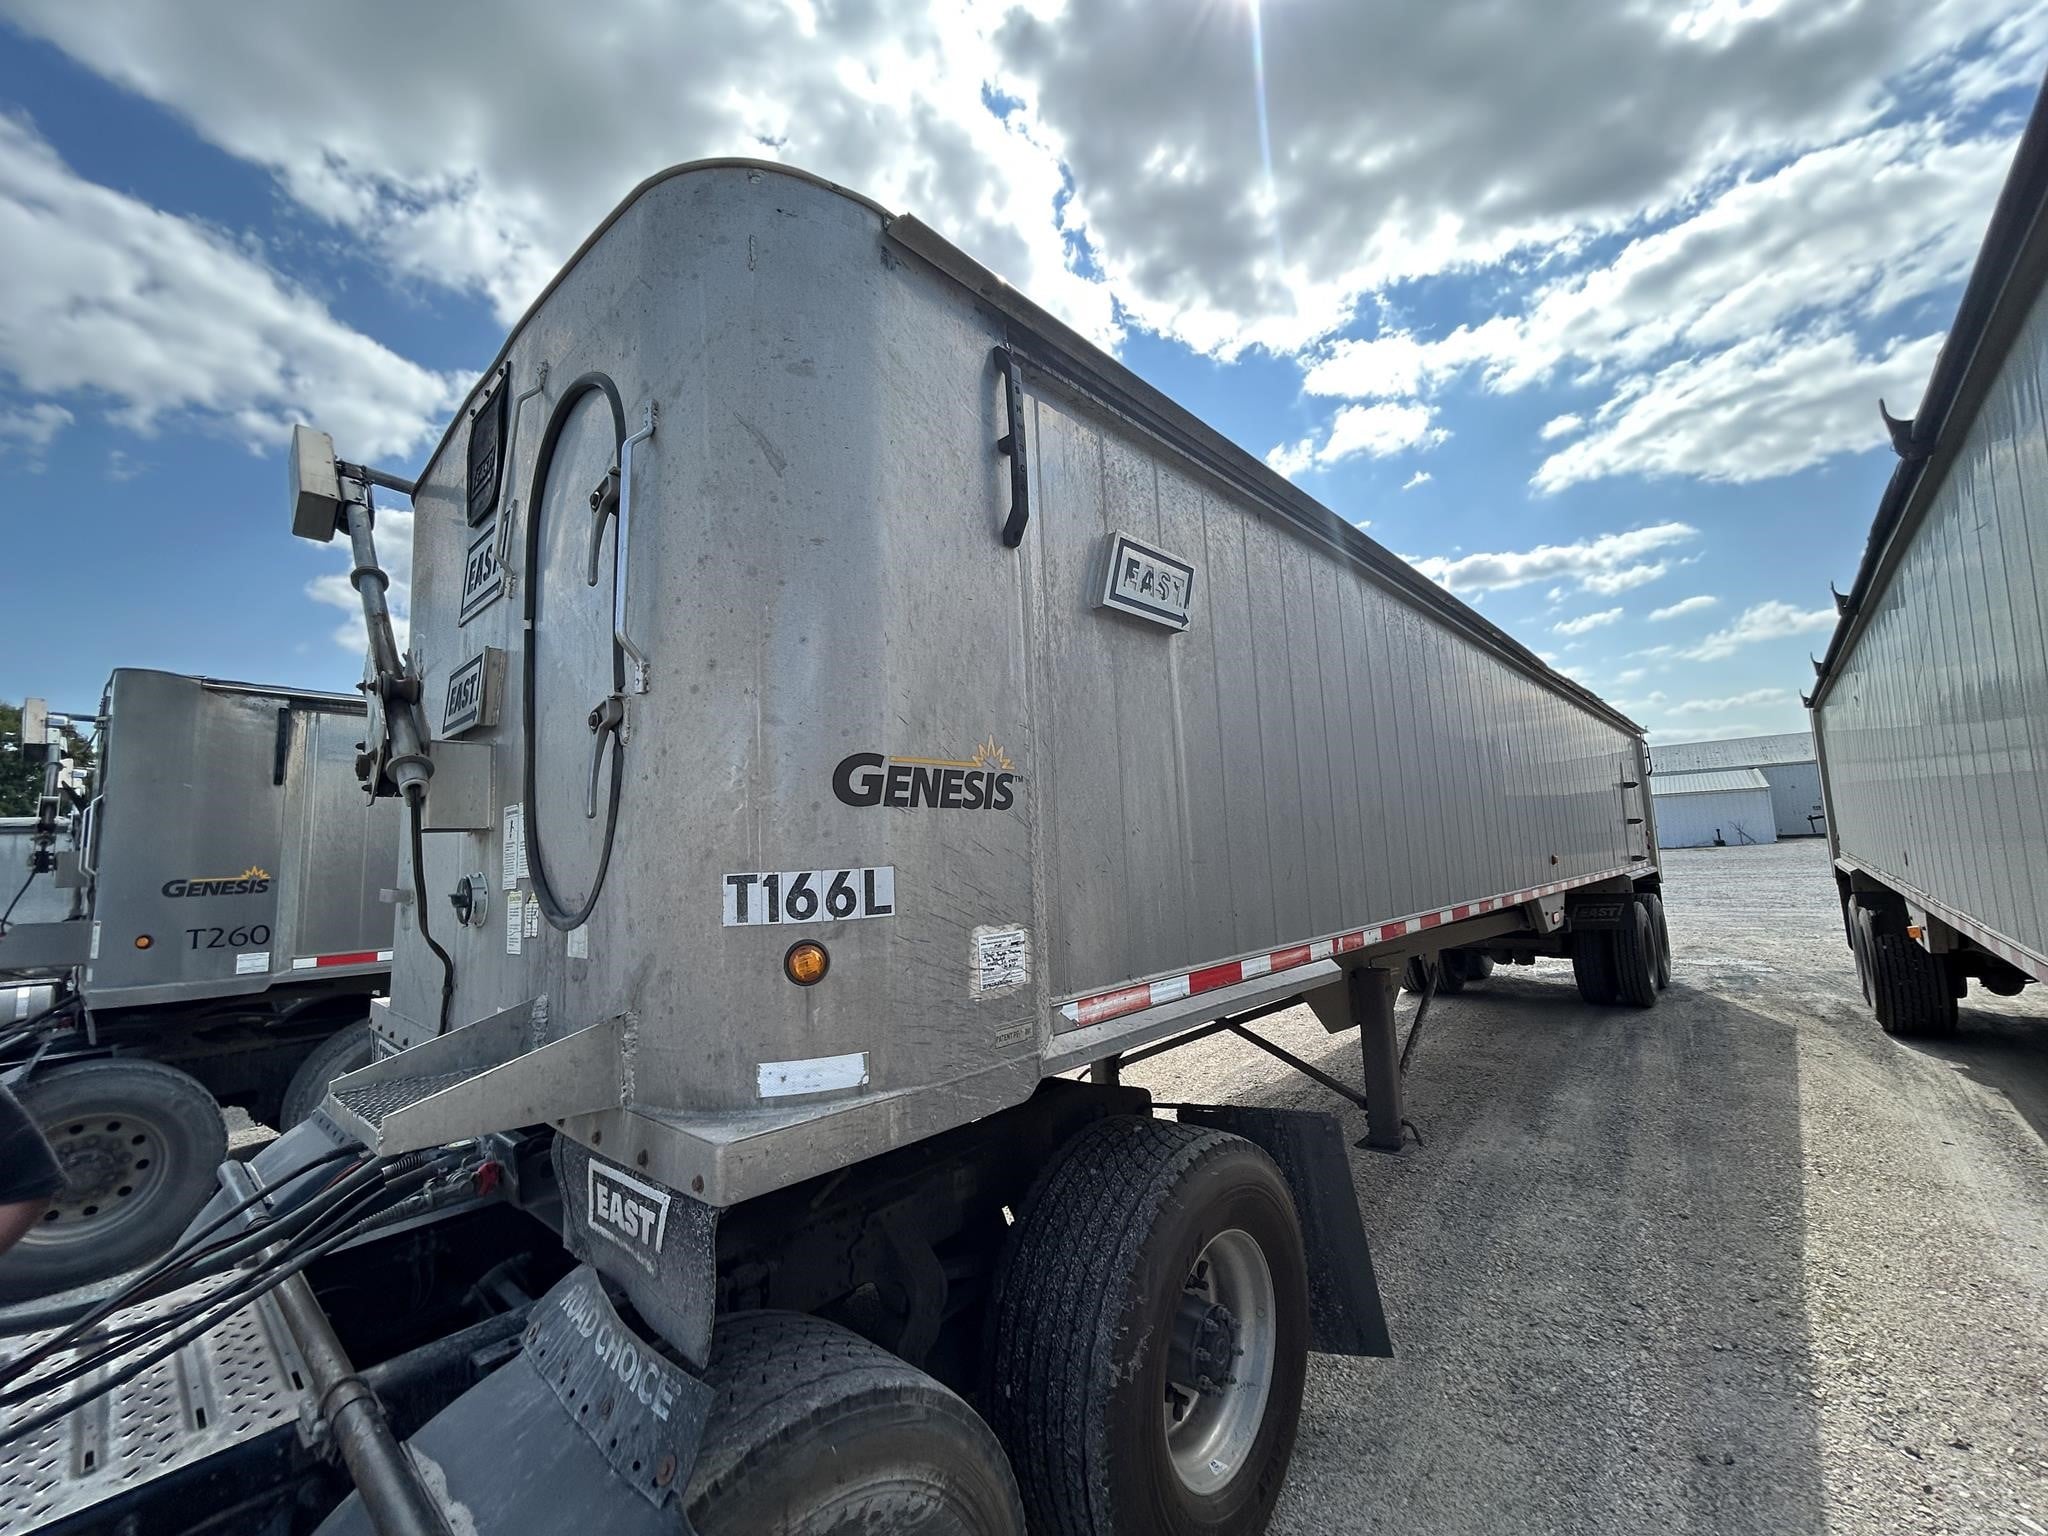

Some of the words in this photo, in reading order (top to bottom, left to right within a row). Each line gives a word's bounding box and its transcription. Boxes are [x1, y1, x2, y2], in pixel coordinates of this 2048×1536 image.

[1123, 557, 1185, 606] EAST
[448, 672, 478, 717] EAST
[832, 752, 1014, 811] GENESIS
[726, 869, 893, 924] T166L
[186, 925, 270, 950] T260
[596, 1184, 656, 1245] EAST
[595, 1324, 676, 1423] CHOICE
